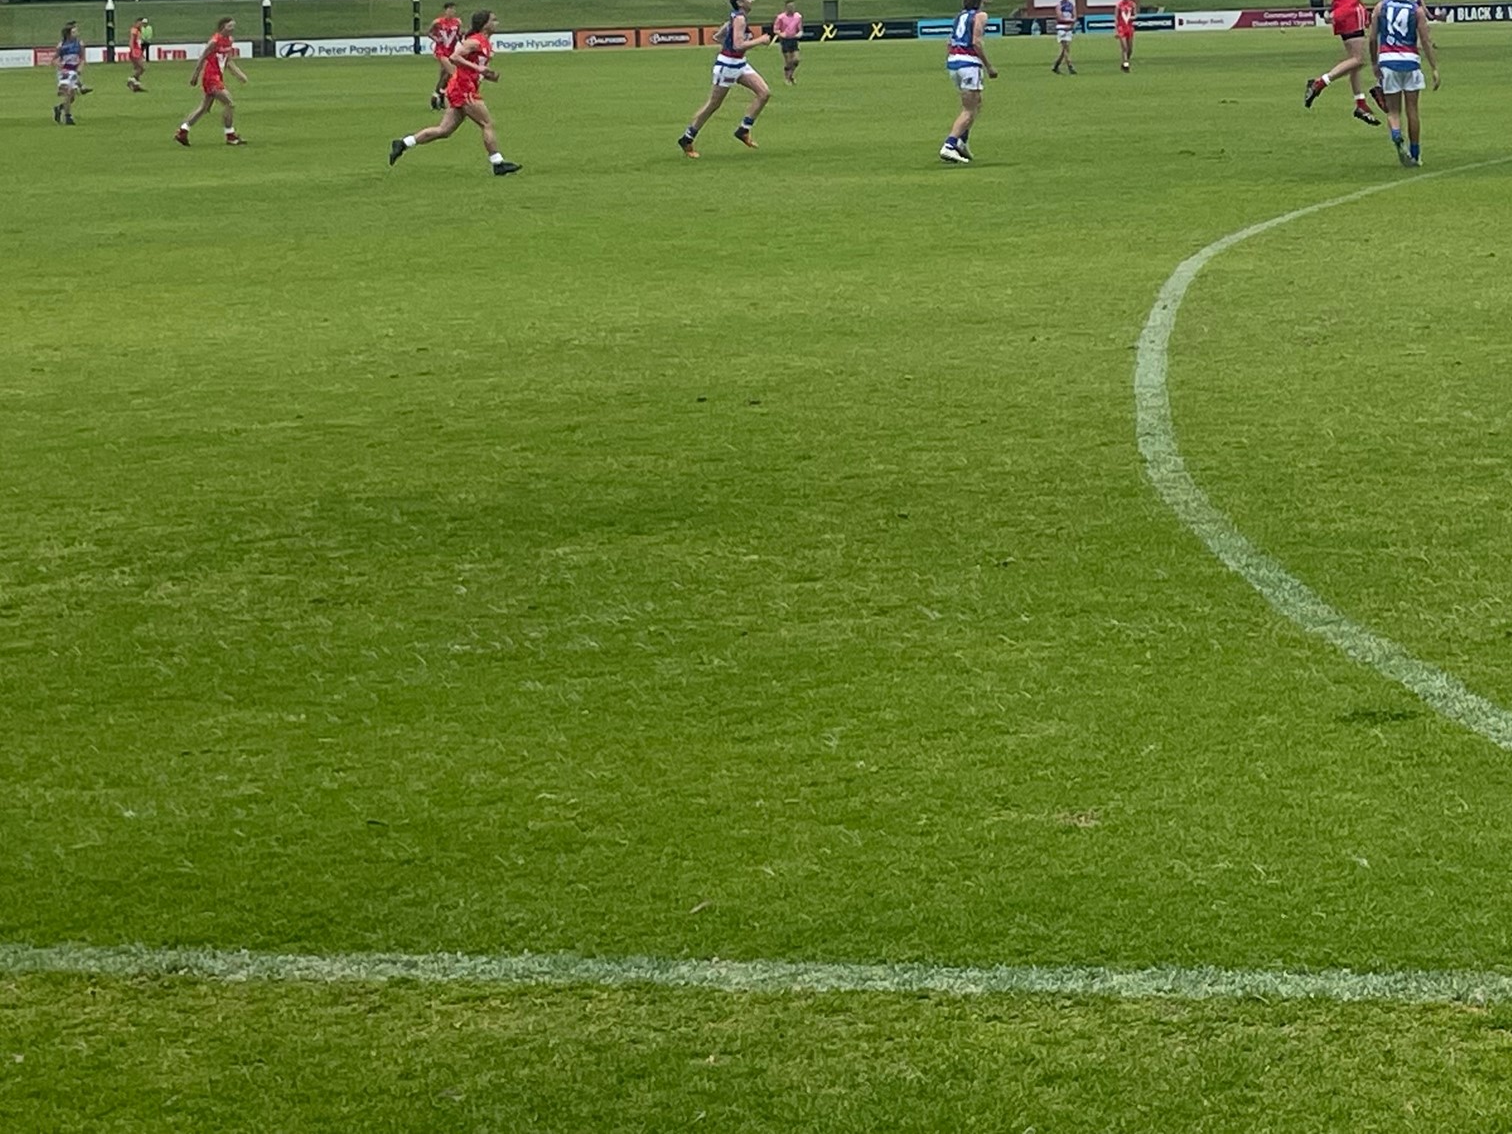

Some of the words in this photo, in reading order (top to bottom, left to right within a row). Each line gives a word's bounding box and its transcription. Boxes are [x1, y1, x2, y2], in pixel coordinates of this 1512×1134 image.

[1457, 7, 1491, 21] BLACK
[1494, 6, 1504, 19] &
[1386, 7, 1410, 37] 14
[318, 45, 347, 54] Peter
[349, 44, 377, 55] Page
[496, 39, 524, 50] Page
